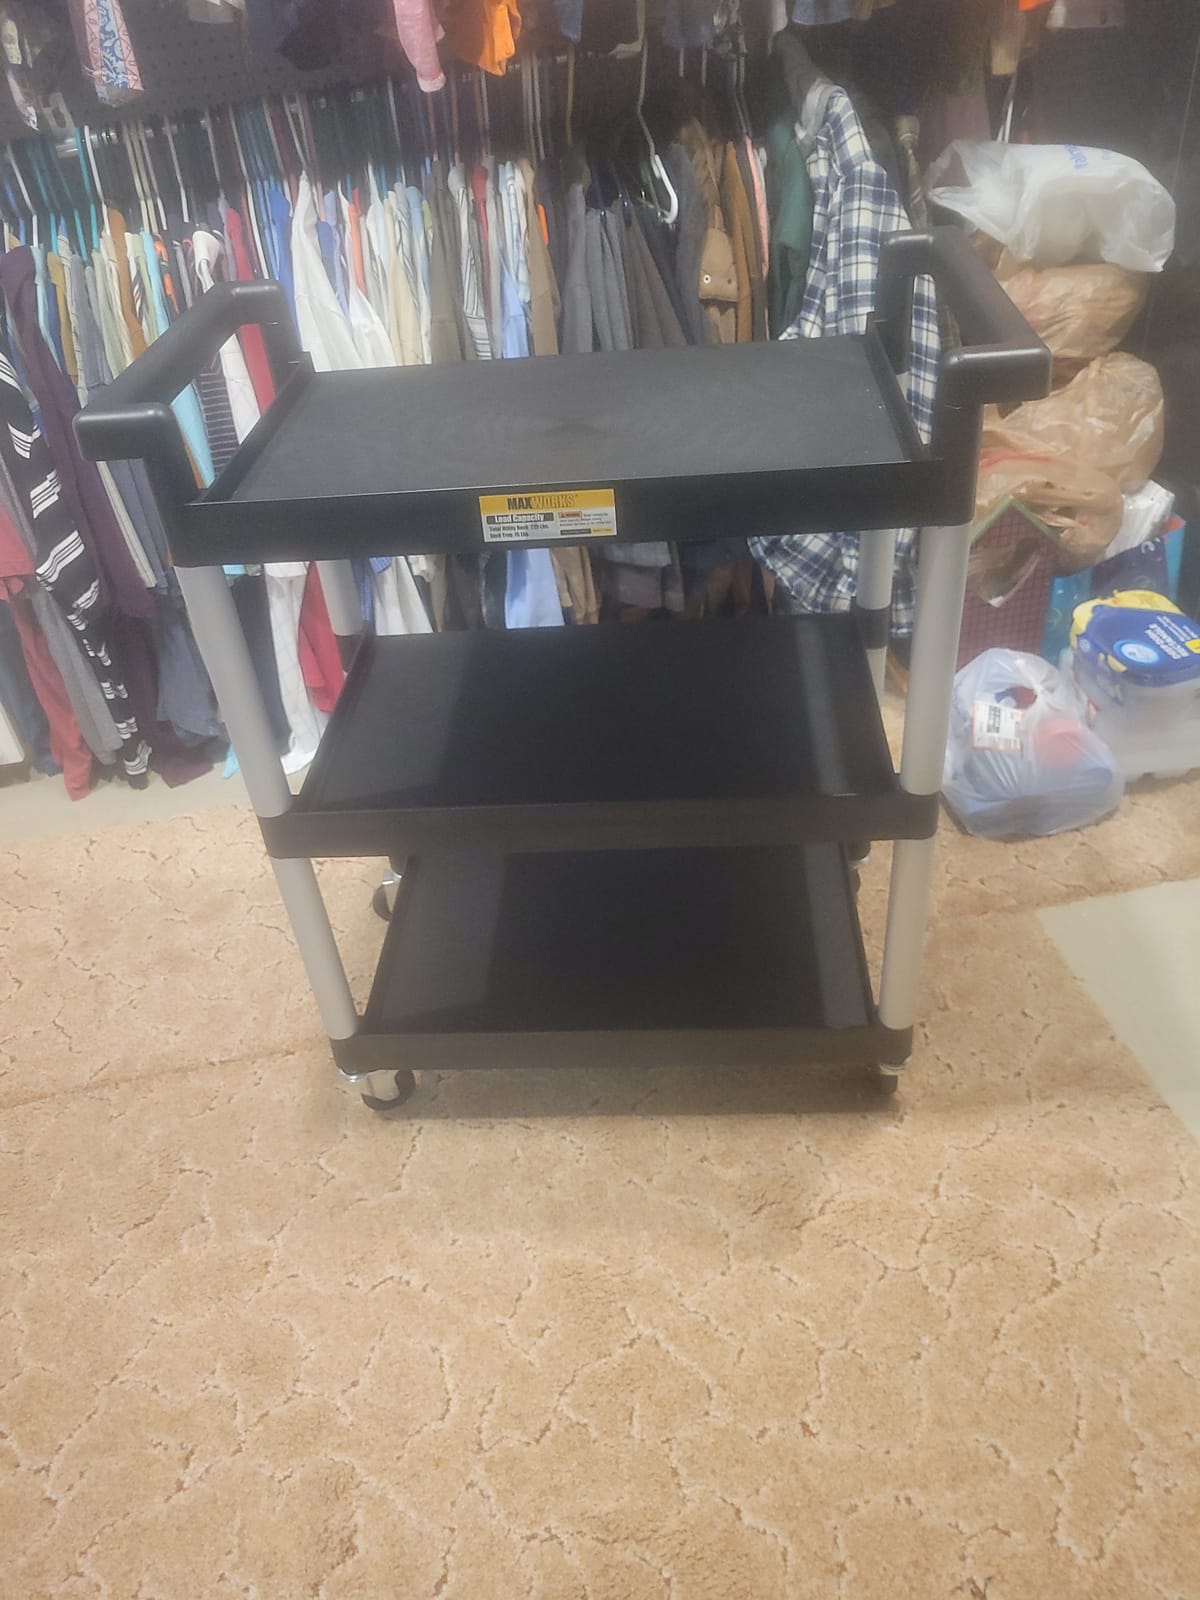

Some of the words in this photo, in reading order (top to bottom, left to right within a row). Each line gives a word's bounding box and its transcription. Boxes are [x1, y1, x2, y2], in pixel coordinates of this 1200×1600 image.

[507, 494, 574, 510] MAXWORKS
[495, 514, 512, 523] Load
[512, 513, 545, 523] Capacity
